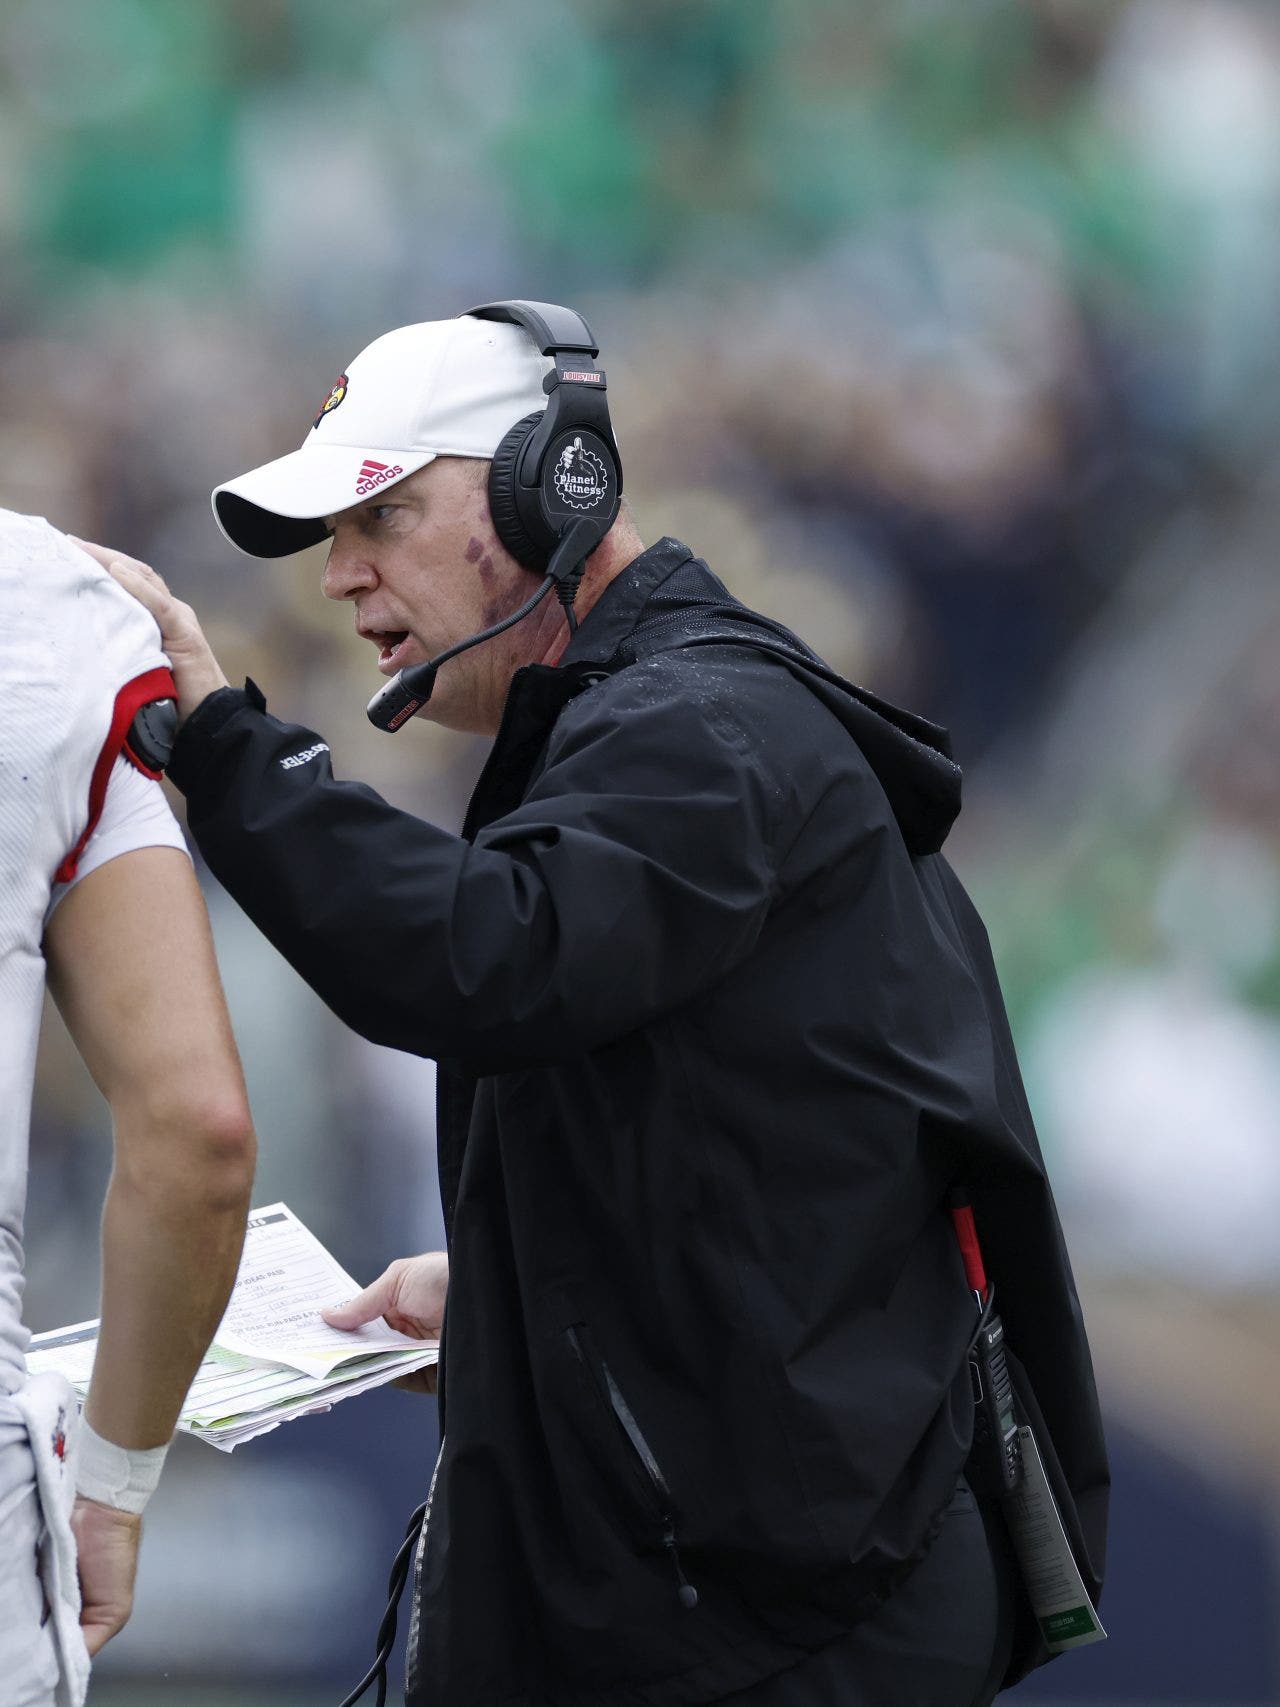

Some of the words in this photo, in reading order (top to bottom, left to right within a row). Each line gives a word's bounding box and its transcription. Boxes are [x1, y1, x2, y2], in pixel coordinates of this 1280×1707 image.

[563, 371, 600, 382] LOUISVILLE
[355, 465, 404, 495] adidas
[560, 473, 595, 485] planet
[564, 483, 601, 495] fitness
[280, 743, 330, 769] GORE-TEX
